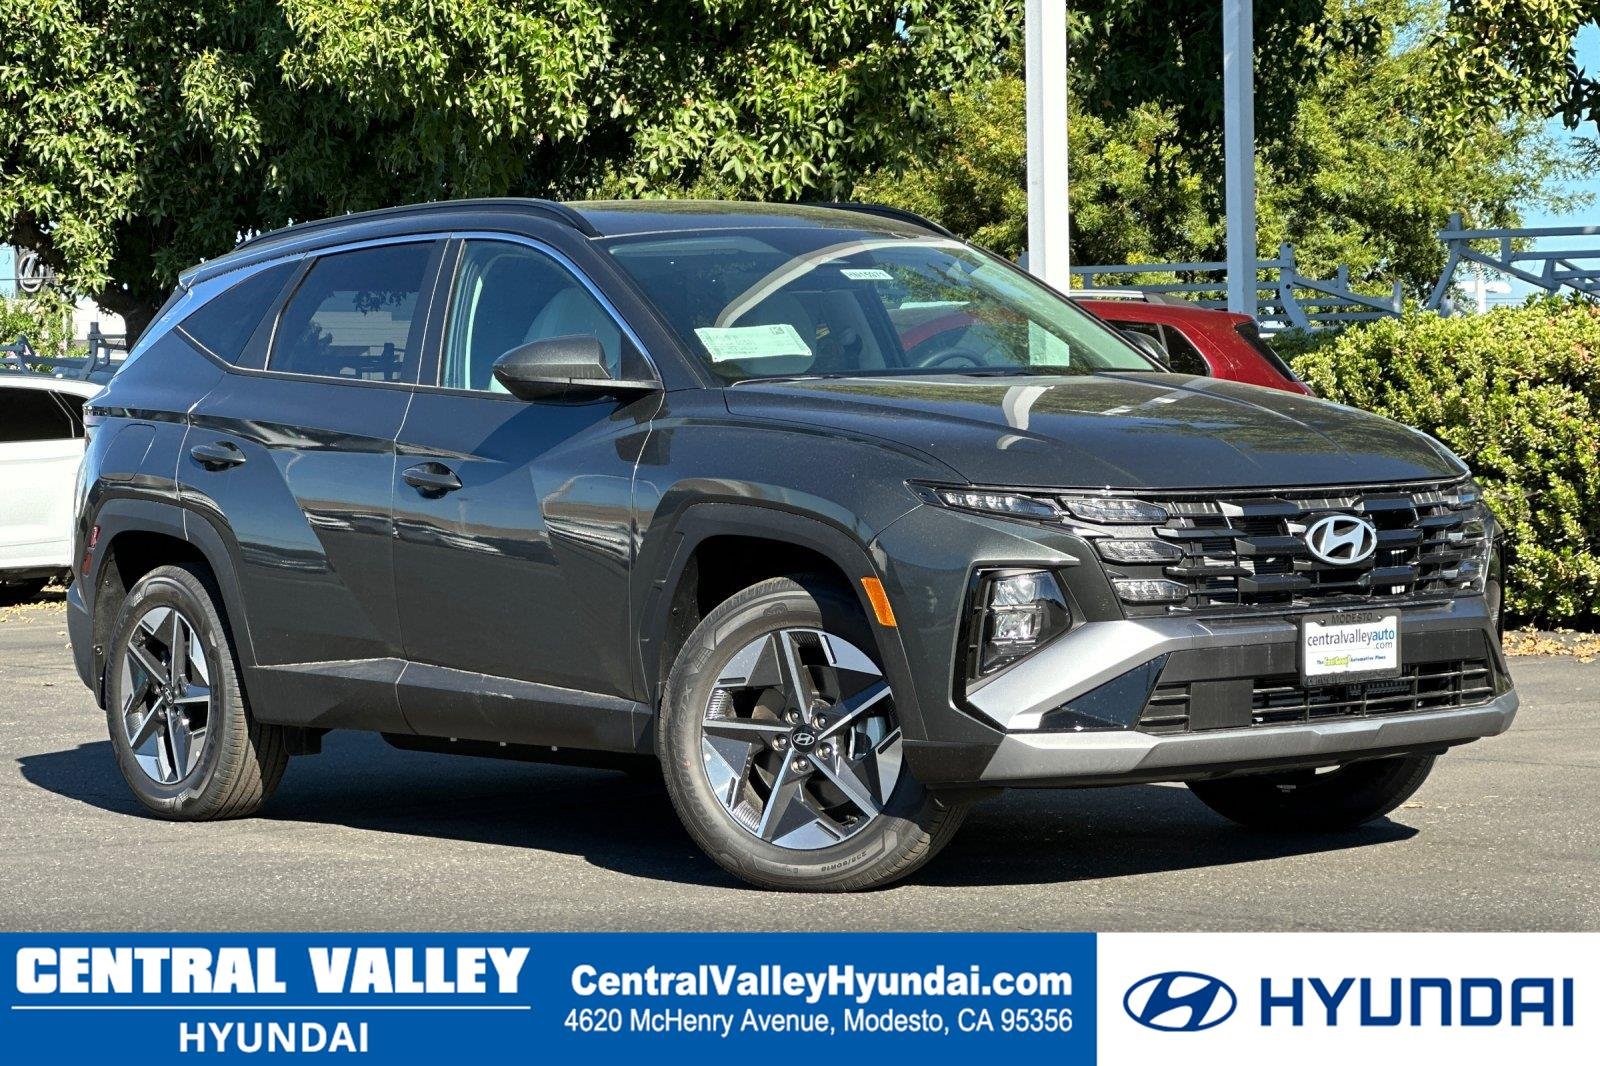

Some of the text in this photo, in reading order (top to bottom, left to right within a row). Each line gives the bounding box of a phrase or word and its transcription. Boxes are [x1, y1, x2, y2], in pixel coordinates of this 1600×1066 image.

[1331, 612, 1373, 624] MODESTO
[1307, 628, 1395, 647] centralvalleyauto
[1374, 641, 1393, 650] .com
